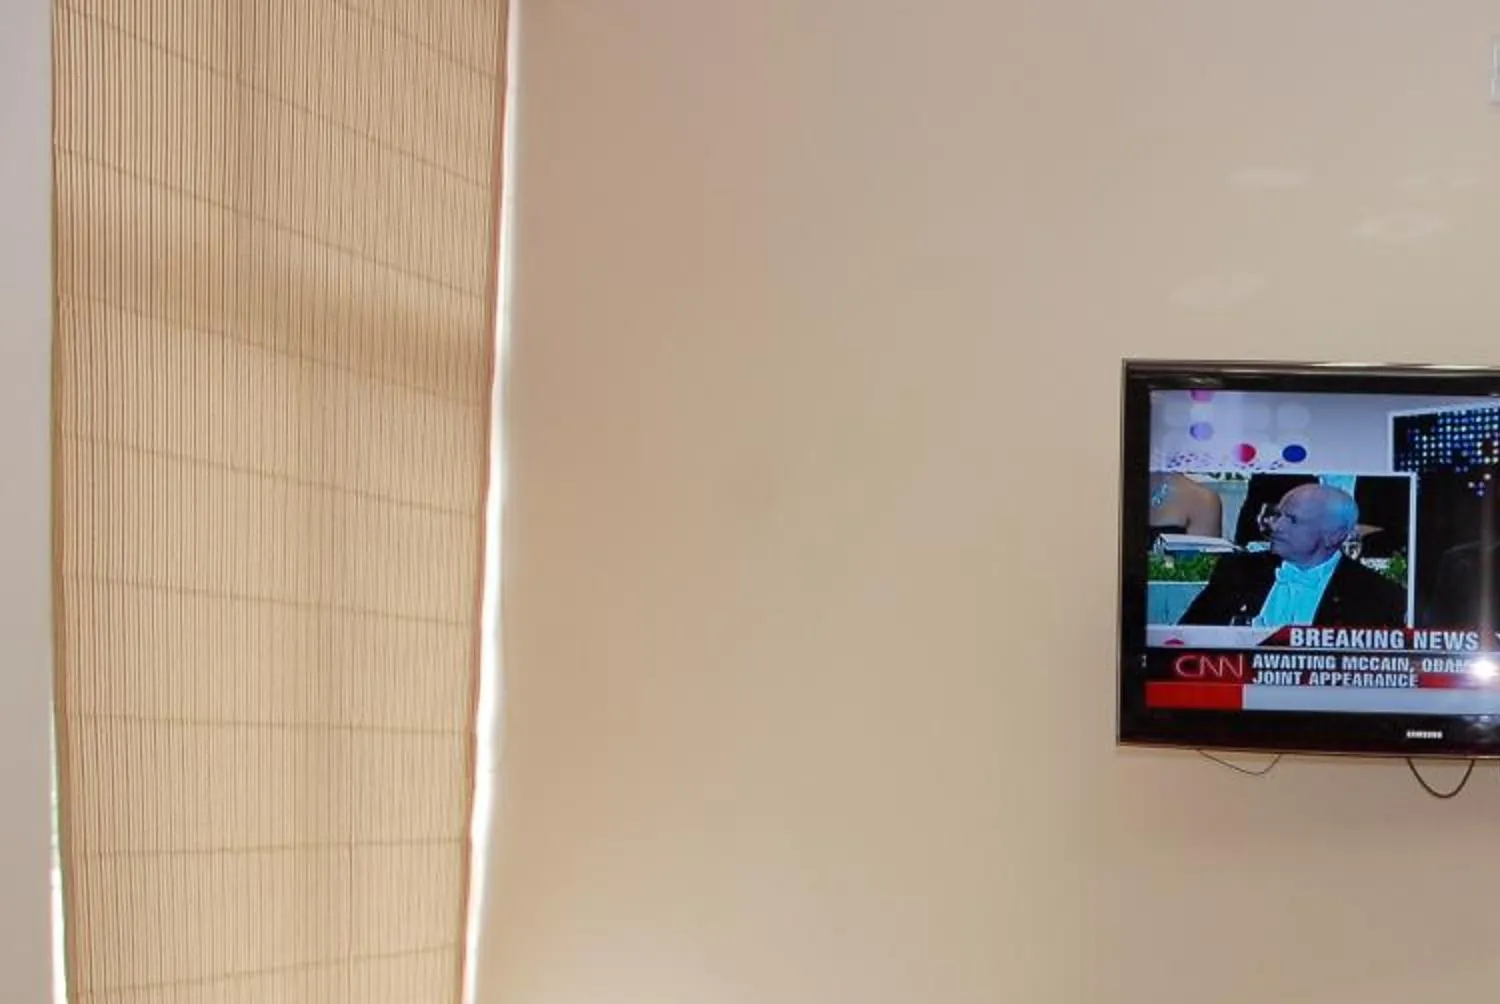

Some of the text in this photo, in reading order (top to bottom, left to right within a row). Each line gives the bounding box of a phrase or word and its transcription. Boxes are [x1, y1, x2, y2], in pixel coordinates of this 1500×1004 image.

[1290, 627, 1480, 650] BREAKING NEWS
[1174, 654, 1244, 678] CNN
[1252, 653, 1336, 671] AWAITING
[1342, 655, 1415, 673] MCCAIN,
[1252, 671, 1419, 688] JOINT APPEARANCE
